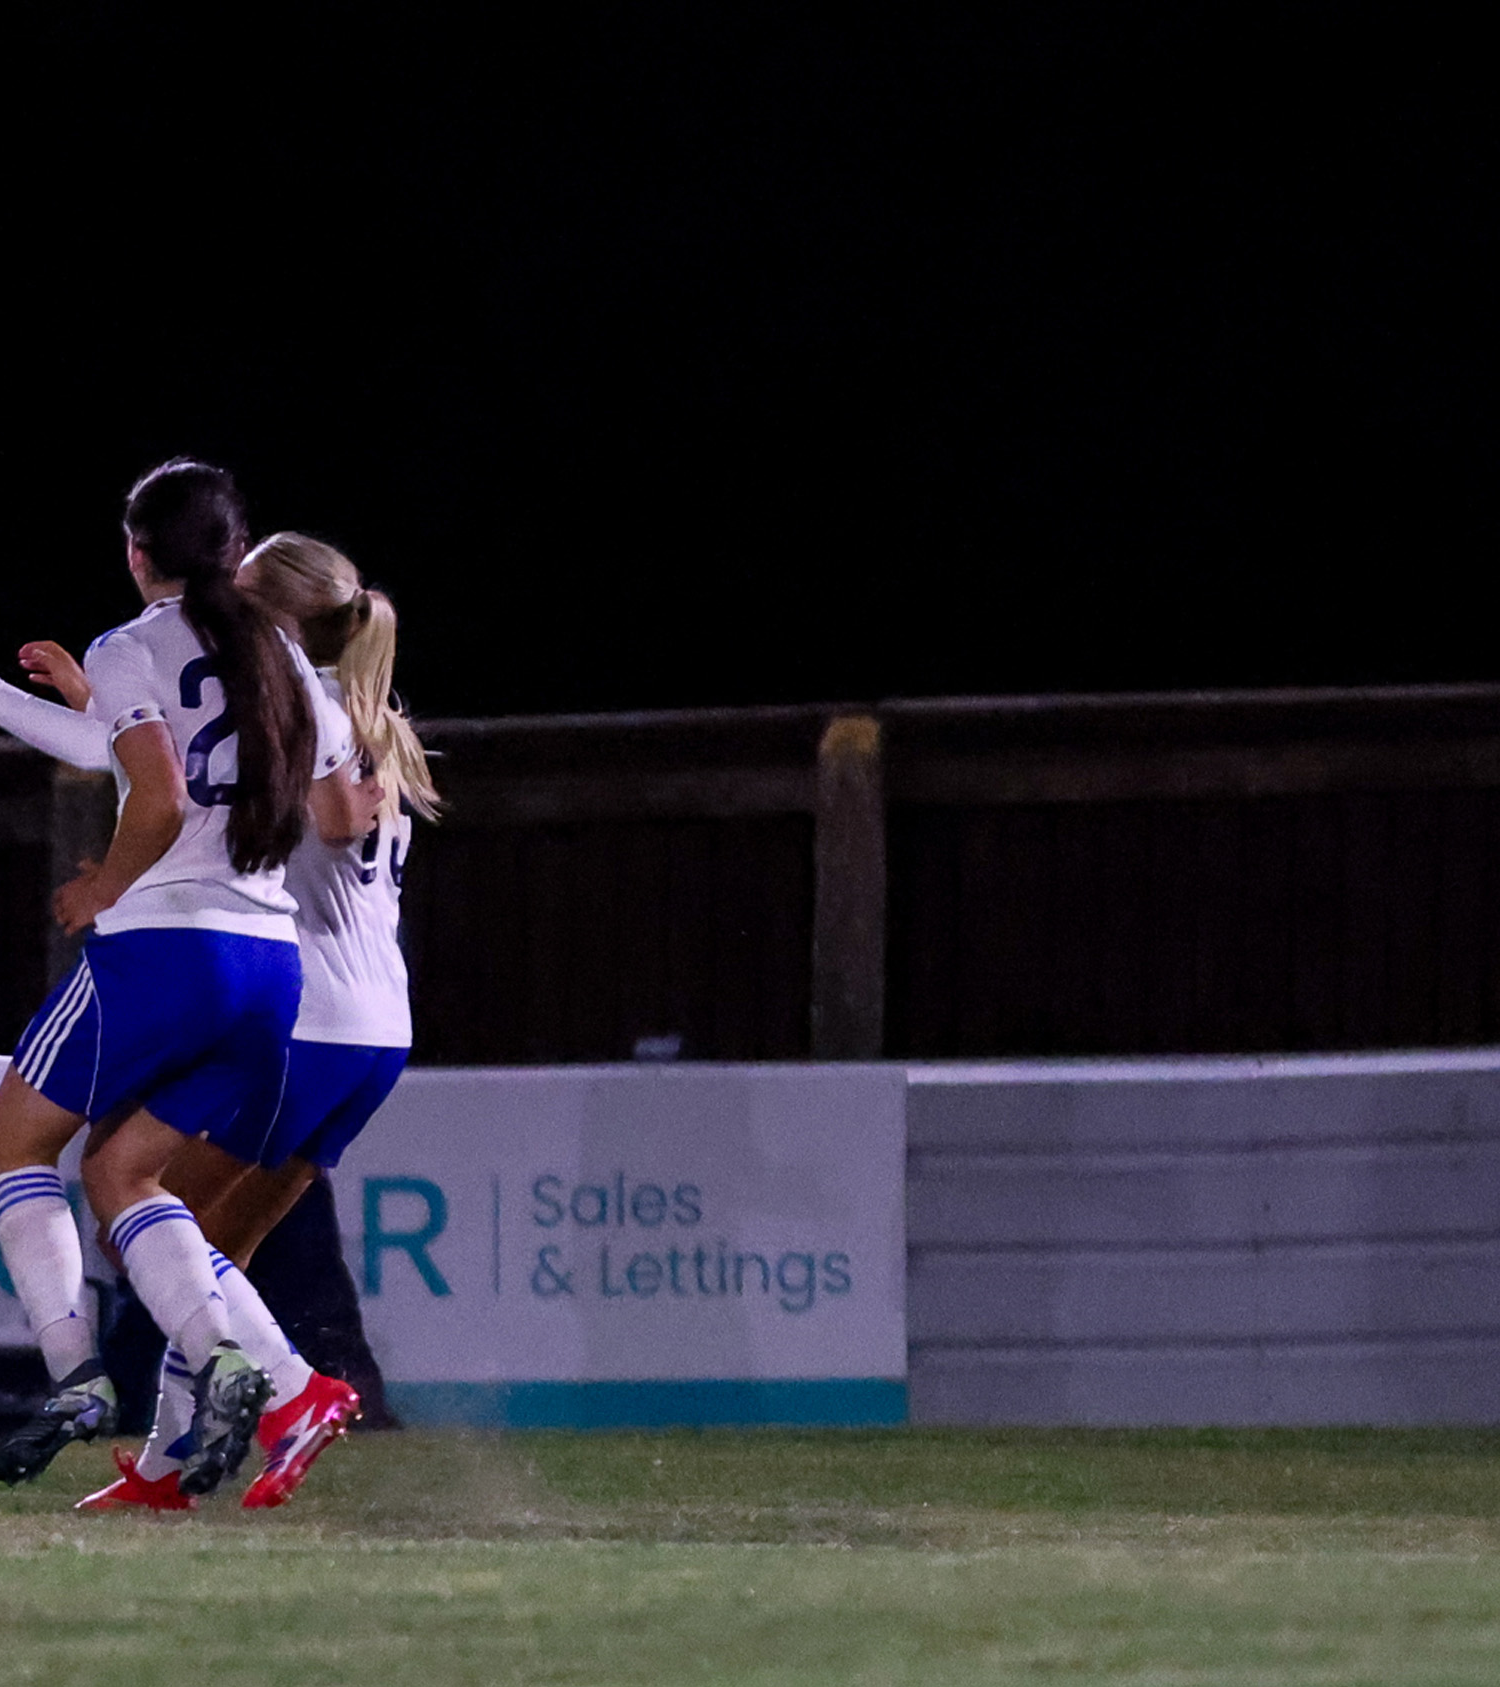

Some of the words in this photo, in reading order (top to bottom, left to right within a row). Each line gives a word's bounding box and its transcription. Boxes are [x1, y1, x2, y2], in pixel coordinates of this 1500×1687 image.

[531, 1170, 703, 1228] Sales
[530, 1244, 575, 1298] &
[600, 1237, 853, 1313] Lettings
